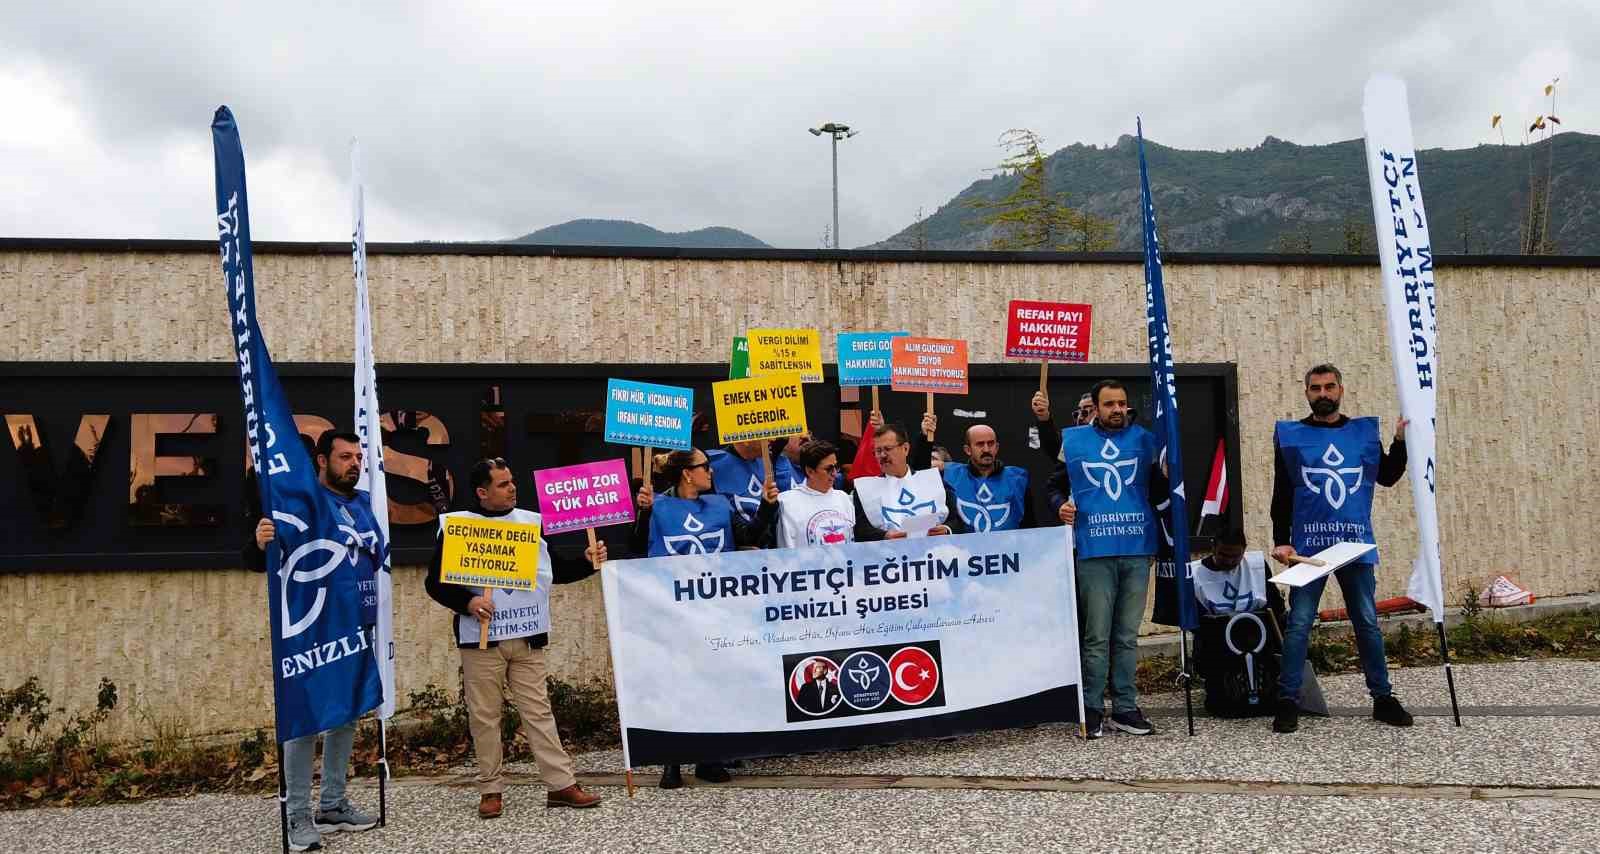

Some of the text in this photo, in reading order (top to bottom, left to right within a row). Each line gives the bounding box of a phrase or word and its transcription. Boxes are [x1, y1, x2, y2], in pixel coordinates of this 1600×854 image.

[1380, 150, 1433, 389] HÜRRİYETÇİ
[1016, 308, 1083, 322] REFAH PAYI
[1020, 322, 1078, 335] HAKKIMIZ
[757, 334, 809, 345] VERGİ DİLİMİ
[905, 343, 921, 352] ALIM
[1019, 335, 1077, 349] ALACAĞIZ
[759, 359, 812, 370] SABİTLENSİN
[845, 359, 886, 369] HAKKIMIZI
[893, 367, 928, 377] HAKKIMIZI
[612, 388, 689, 410] FİKRİ HÜR, VİCDANI HÜR,
[723, 384, 798, 406] EMEK EN YÜCE
[618, 408, 682, 430] İRFANI HÜR SENDİKA
[736, 407, 790, 426] DEĞERDİR.
[544, 473, 620, 496] GEÇİM ZOR
[552, 489, 619, 512] YÜK AĞIR
[1088, 511, 1145, 525] HÜRRİYETÇİ
[447, 524, 537, 544] GEÇİNMEK DEĞİL
[1090, 524, 1144, 537] EĞİTİM-SEN
[466, 542, 516, 557] YAŞAMAK
[460, 554, 519, 572] İSTİYORUZ.
[674, 552, 1020, 601] HÜRRİYETÇİ EĞİTİM SEN
[493, 603, 539, 620] RRİYETÇİ
[765, 588, 929, 622] DENİZLİ ŞUBESİ
[488, 620, 539, 636] İTİM-SEN
[281, 626, 368, 679] ENİZLİ
